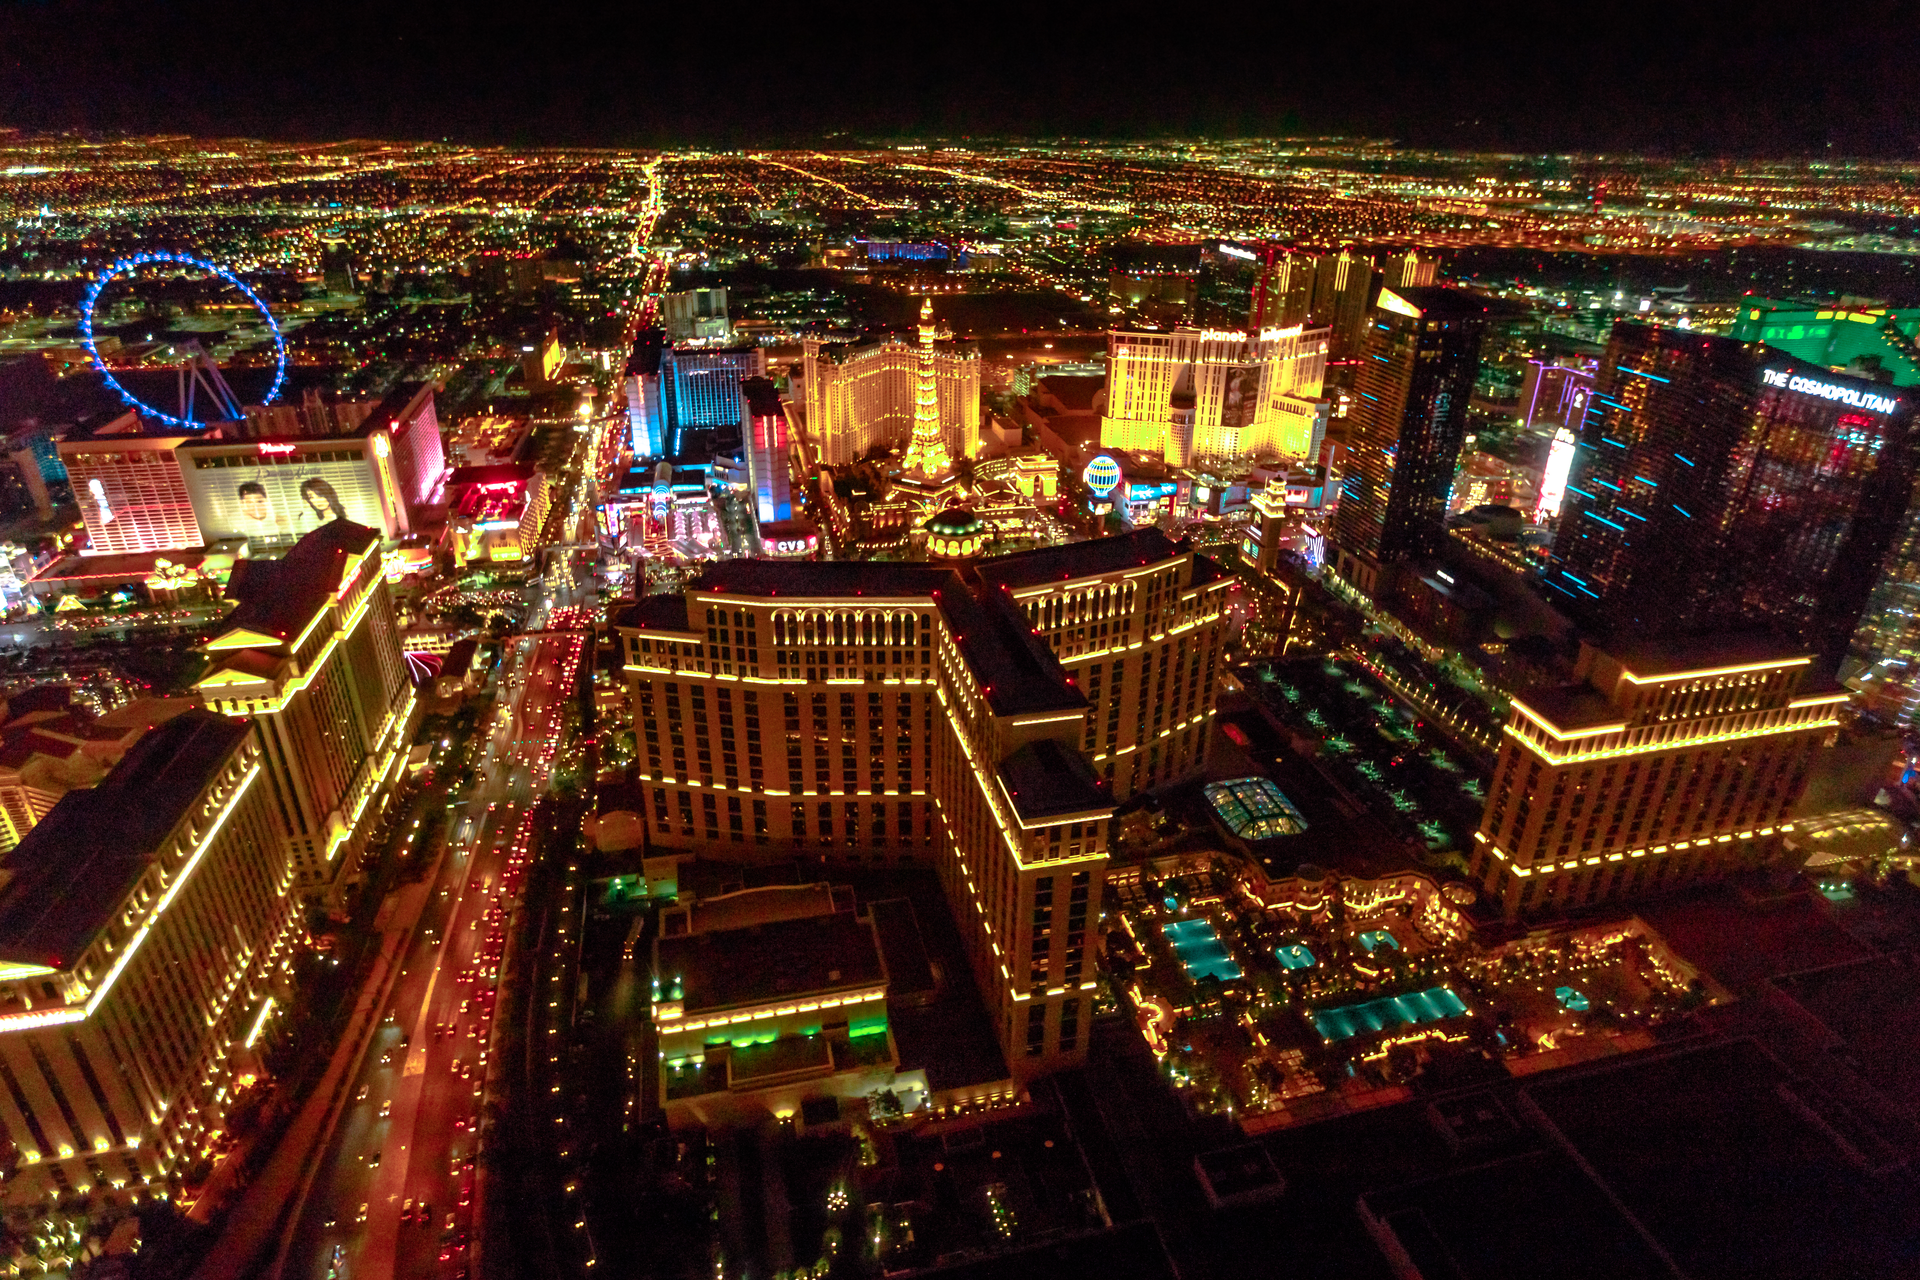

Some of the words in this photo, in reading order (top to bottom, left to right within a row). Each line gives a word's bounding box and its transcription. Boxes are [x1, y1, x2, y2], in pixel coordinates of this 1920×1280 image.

[1200, 327, 1247, 343] planet
[1762, 368, 1790, 388] THE
[1788, 375, 1896, 415] COSMOPOLITAN
[777, 540, 806, 552] CVS
